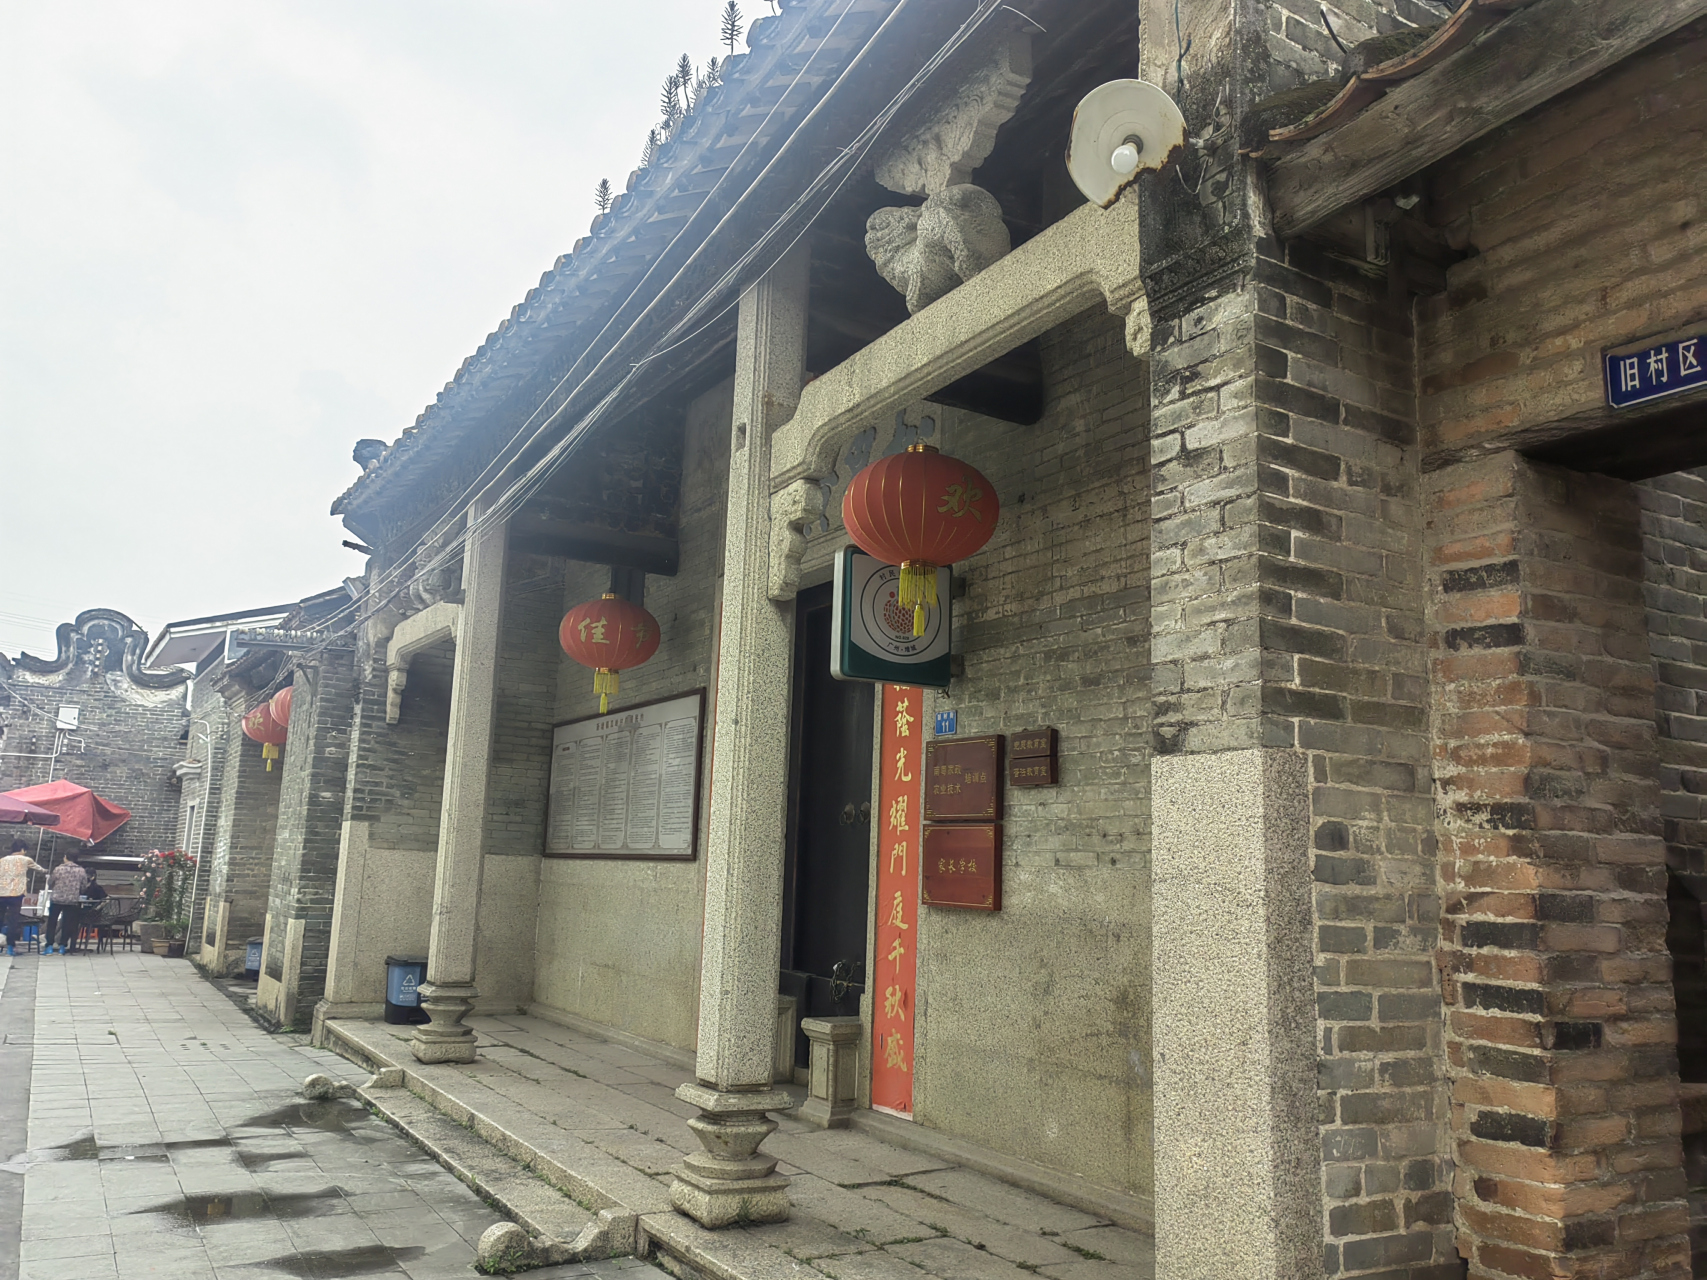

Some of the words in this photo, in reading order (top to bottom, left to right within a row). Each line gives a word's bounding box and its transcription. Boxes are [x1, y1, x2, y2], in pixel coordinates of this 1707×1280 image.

[1620, 339, 1702, 392] 旧村区
[937, 474, 982, 522] 欢
[941, 720, 949, 732] 11
[933, 783, 962, 795] 农业技术
[938, 858, 977, 874] 家长学校
